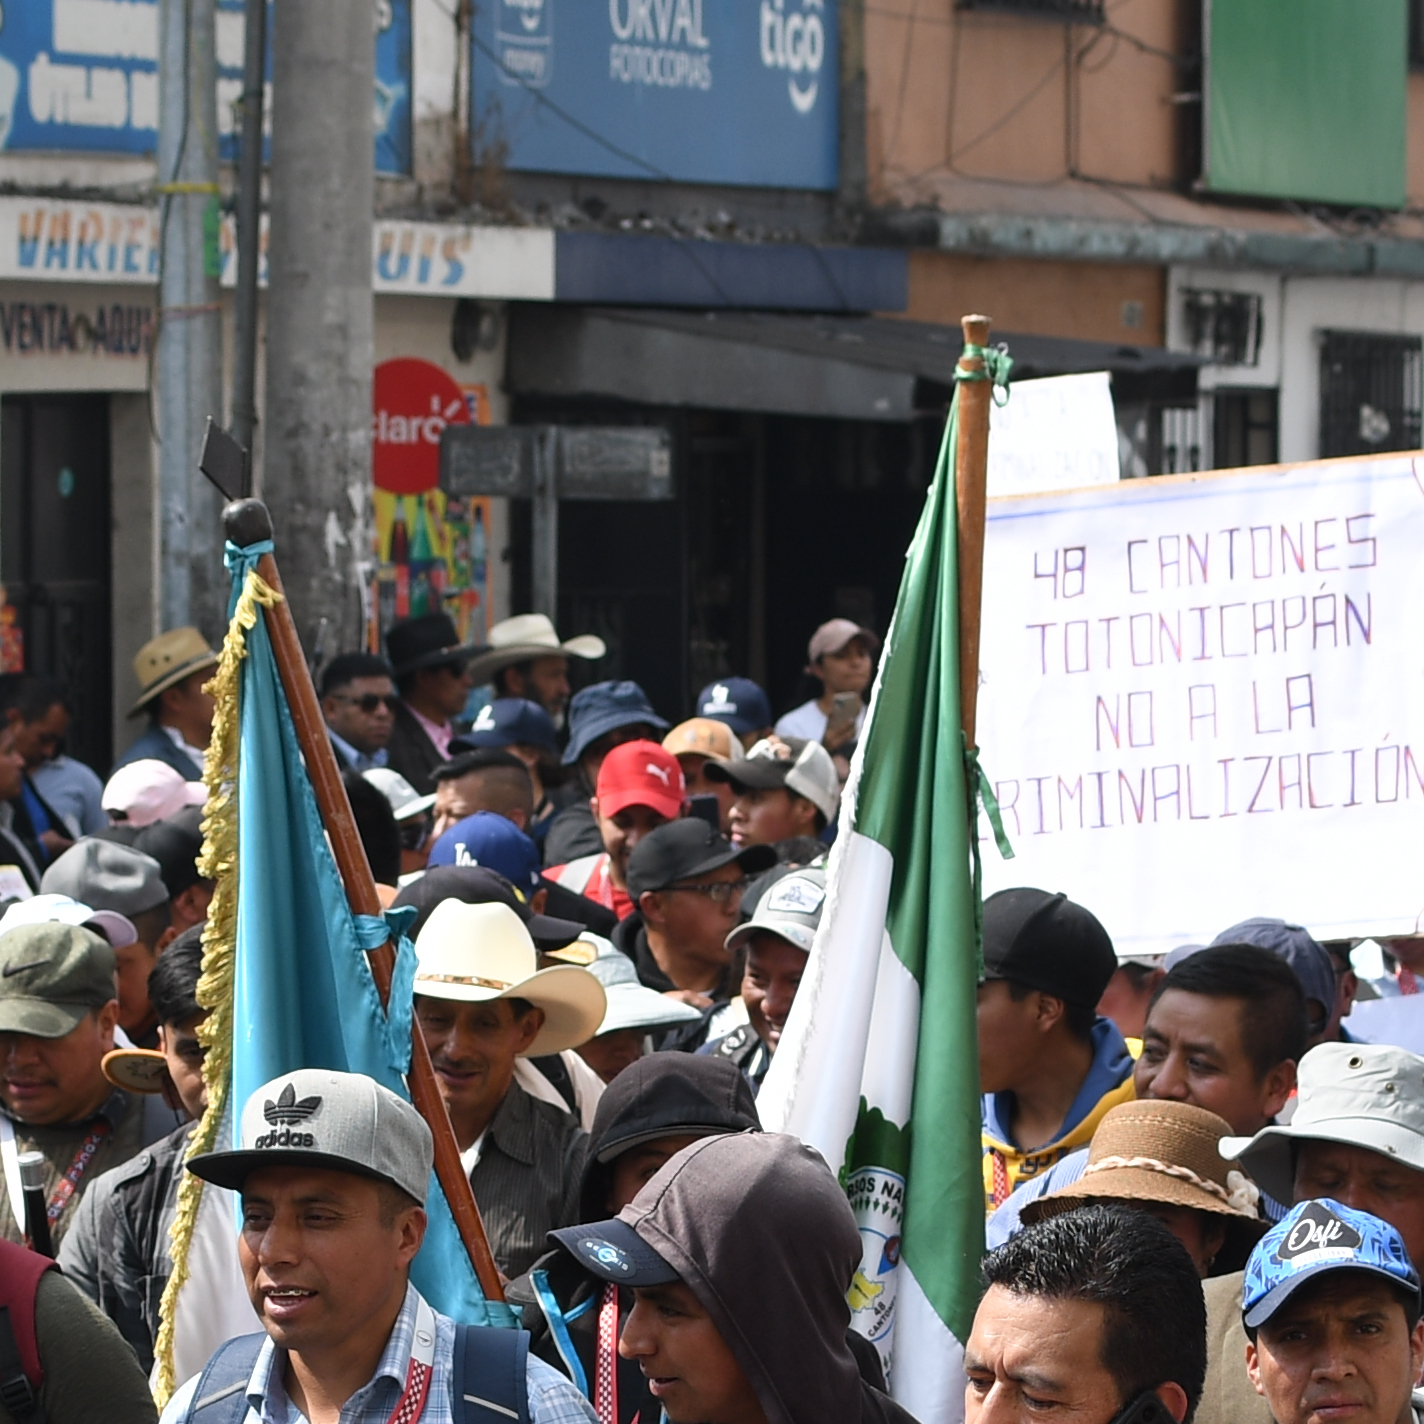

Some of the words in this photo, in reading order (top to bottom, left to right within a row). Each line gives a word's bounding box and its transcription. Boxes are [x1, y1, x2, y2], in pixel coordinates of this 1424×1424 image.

[761, 0, 825, 72] tigo
[1, 300, 74, 354] VENTA
[1034, 545, 1087, 600] 48
[1127, 513, 1377, 595] CANTONES
[1025, 582, 1372, 675] TOTONICAPÁN
[1095, 690, 1155, 751] NO
[1188, 684, 1217, 741] A
[1253, 673, 1316, 735] LA
[255, 1128, 314, 1149] adidas
[847, 1176, 876, 1200] RSOS
[881, 1178, 903, 1203] NA
